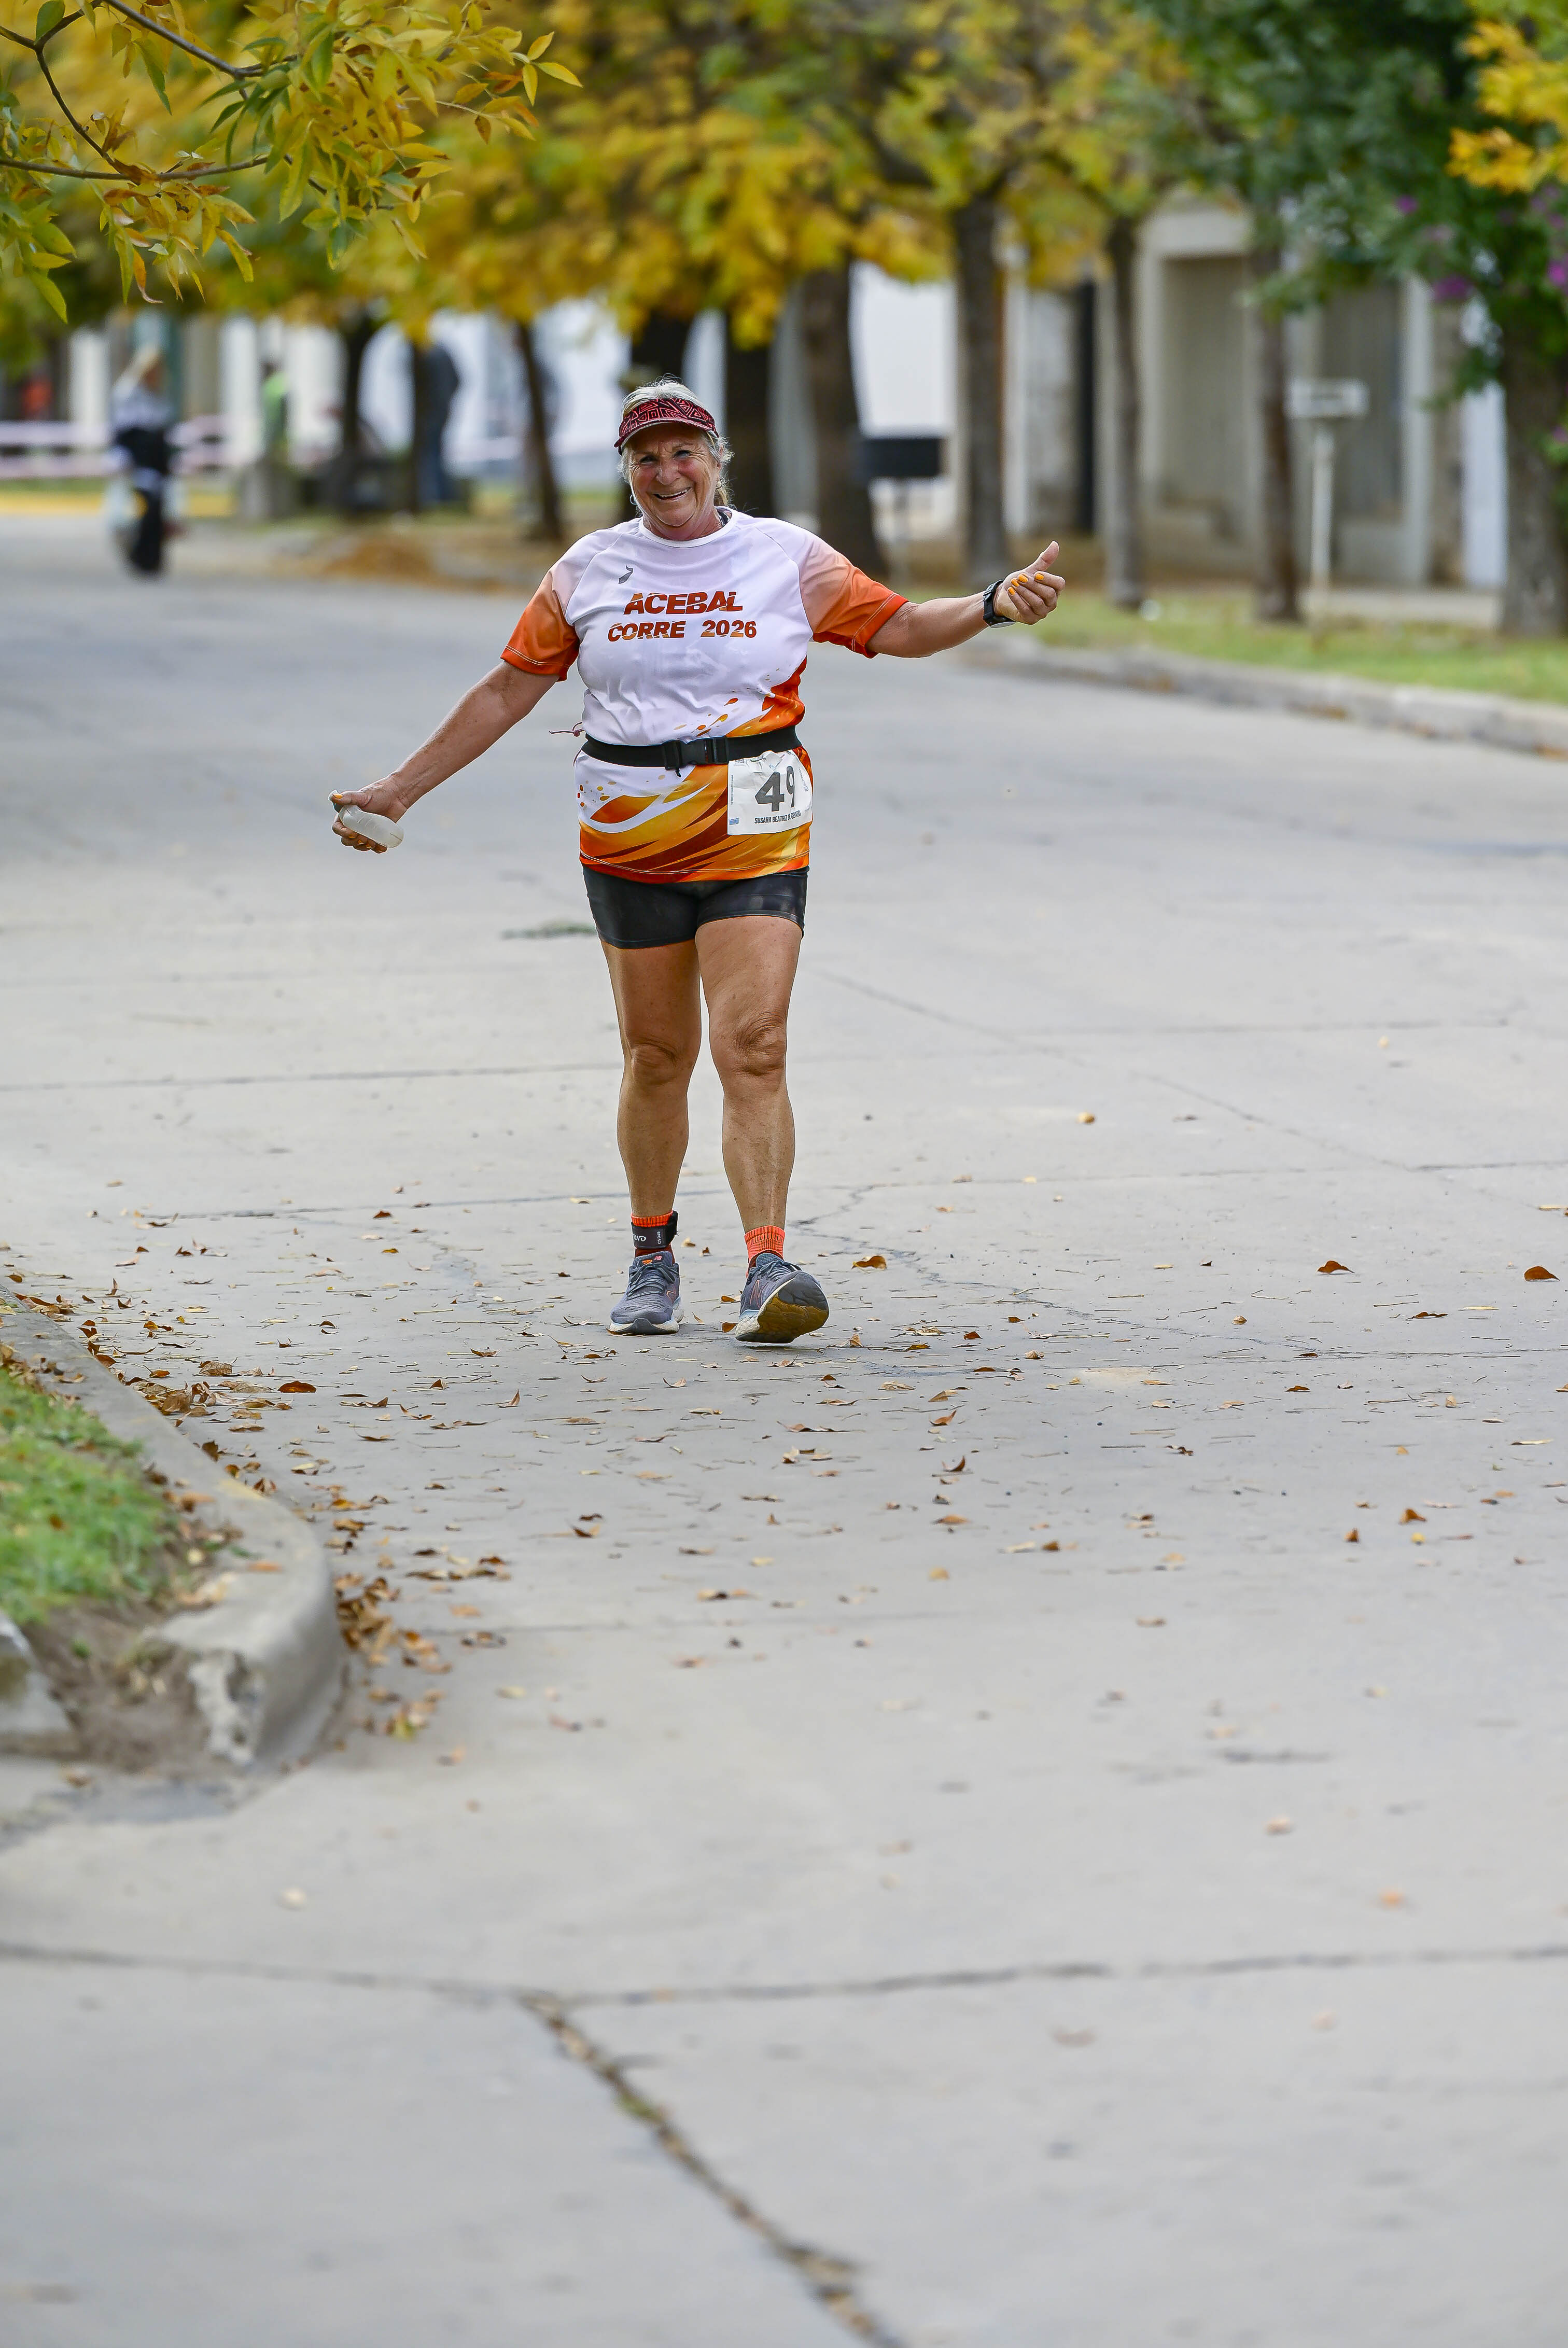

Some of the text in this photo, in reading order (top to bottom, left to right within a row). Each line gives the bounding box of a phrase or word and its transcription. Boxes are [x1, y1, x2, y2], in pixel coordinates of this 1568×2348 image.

[623, 591, 743, 615] ACEBAL
[608, 620, 757, 642] CORRE 2026
[755, 766, 795, 812] 49
